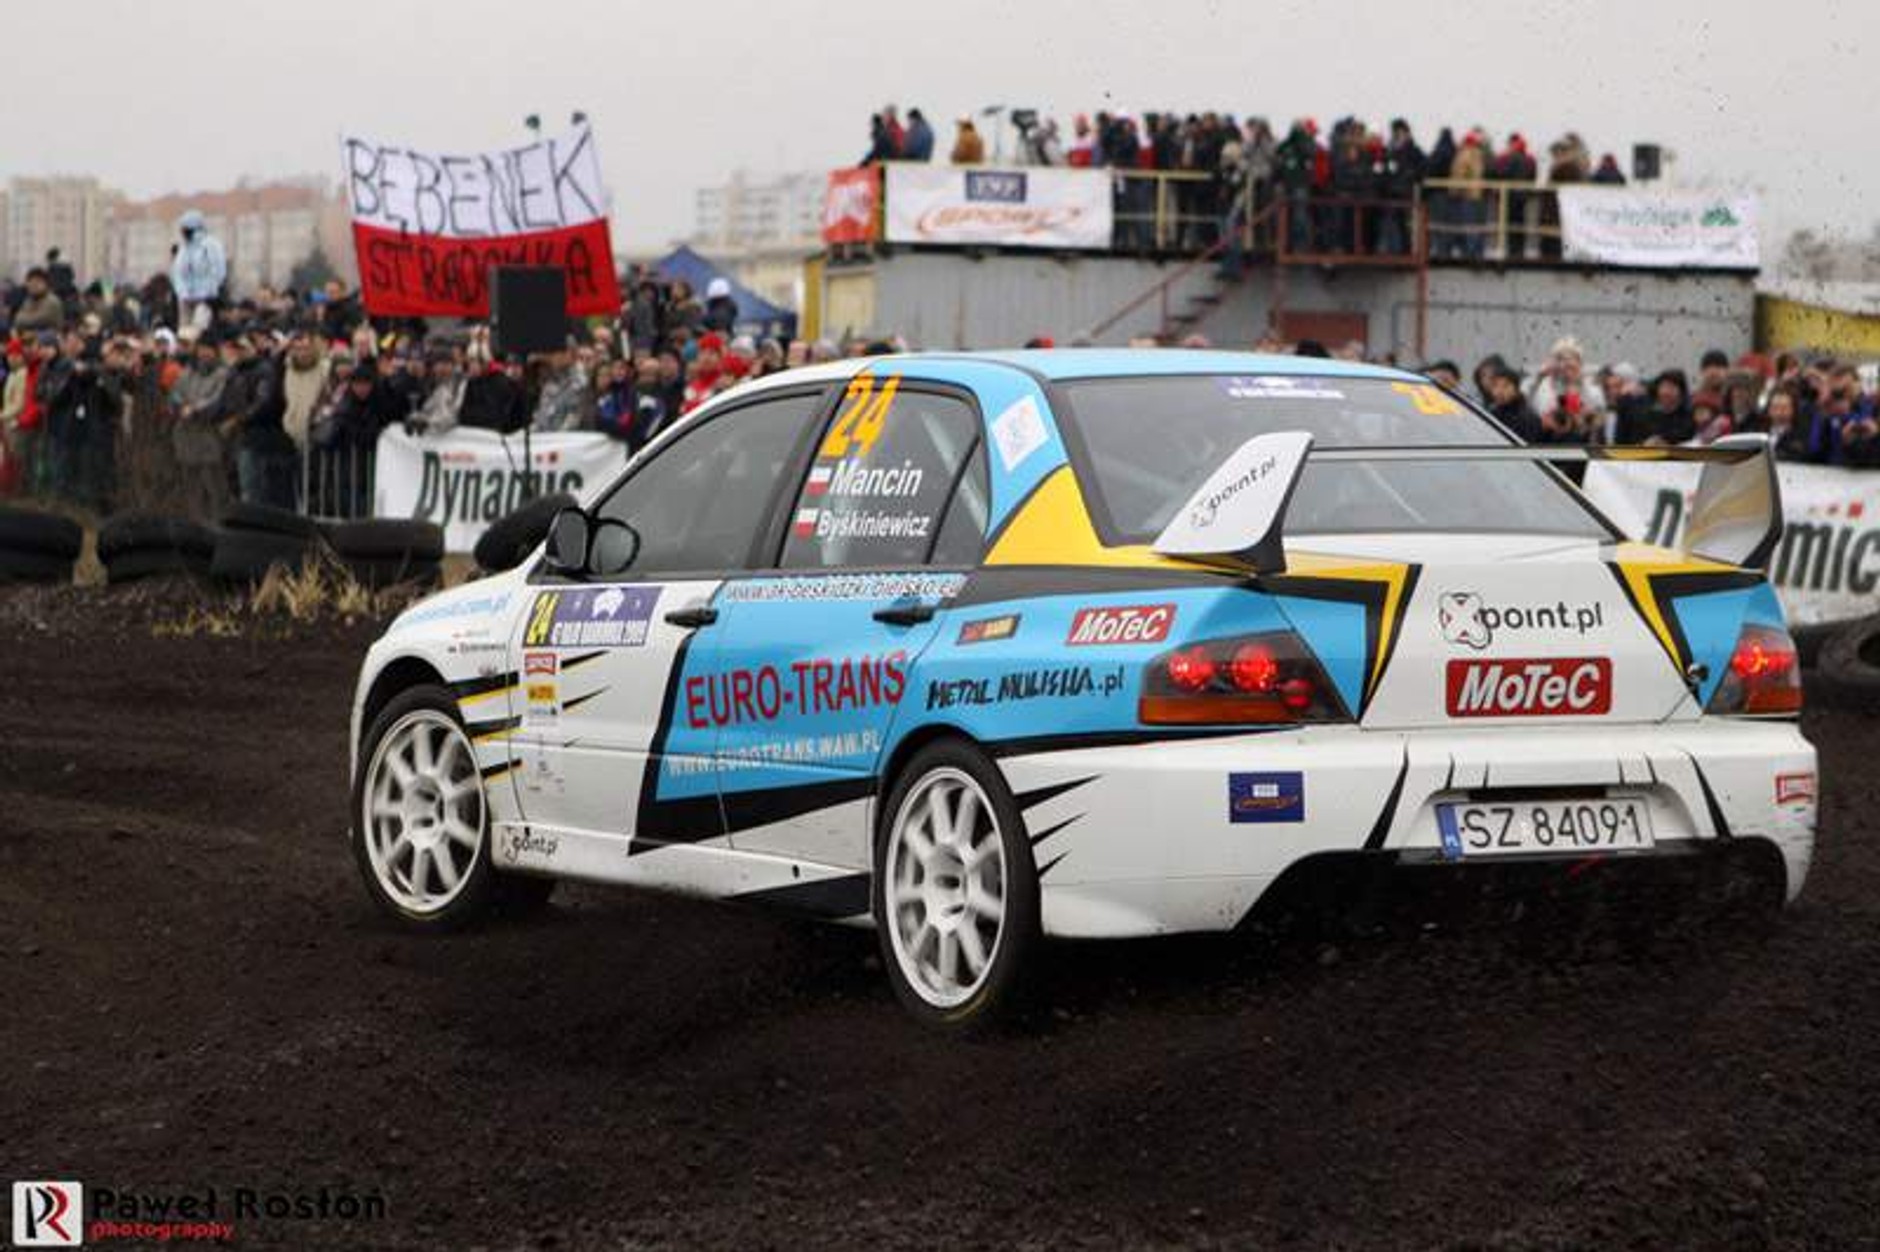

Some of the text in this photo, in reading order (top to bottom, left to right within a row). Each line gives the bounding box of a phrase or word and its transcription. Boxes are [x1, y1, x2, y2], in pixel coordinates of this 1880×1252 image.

[820, 371, 904, 461] 24
[829, 459, 922, 497] Mancin
[1071, 608, 1166, 643] MoTeC
[685, 650, 907, 730] EURO-TRANS
[1456, 663, 1600, 711] MoTeC
[1462, 803, 1643, 848] SZ 84091
